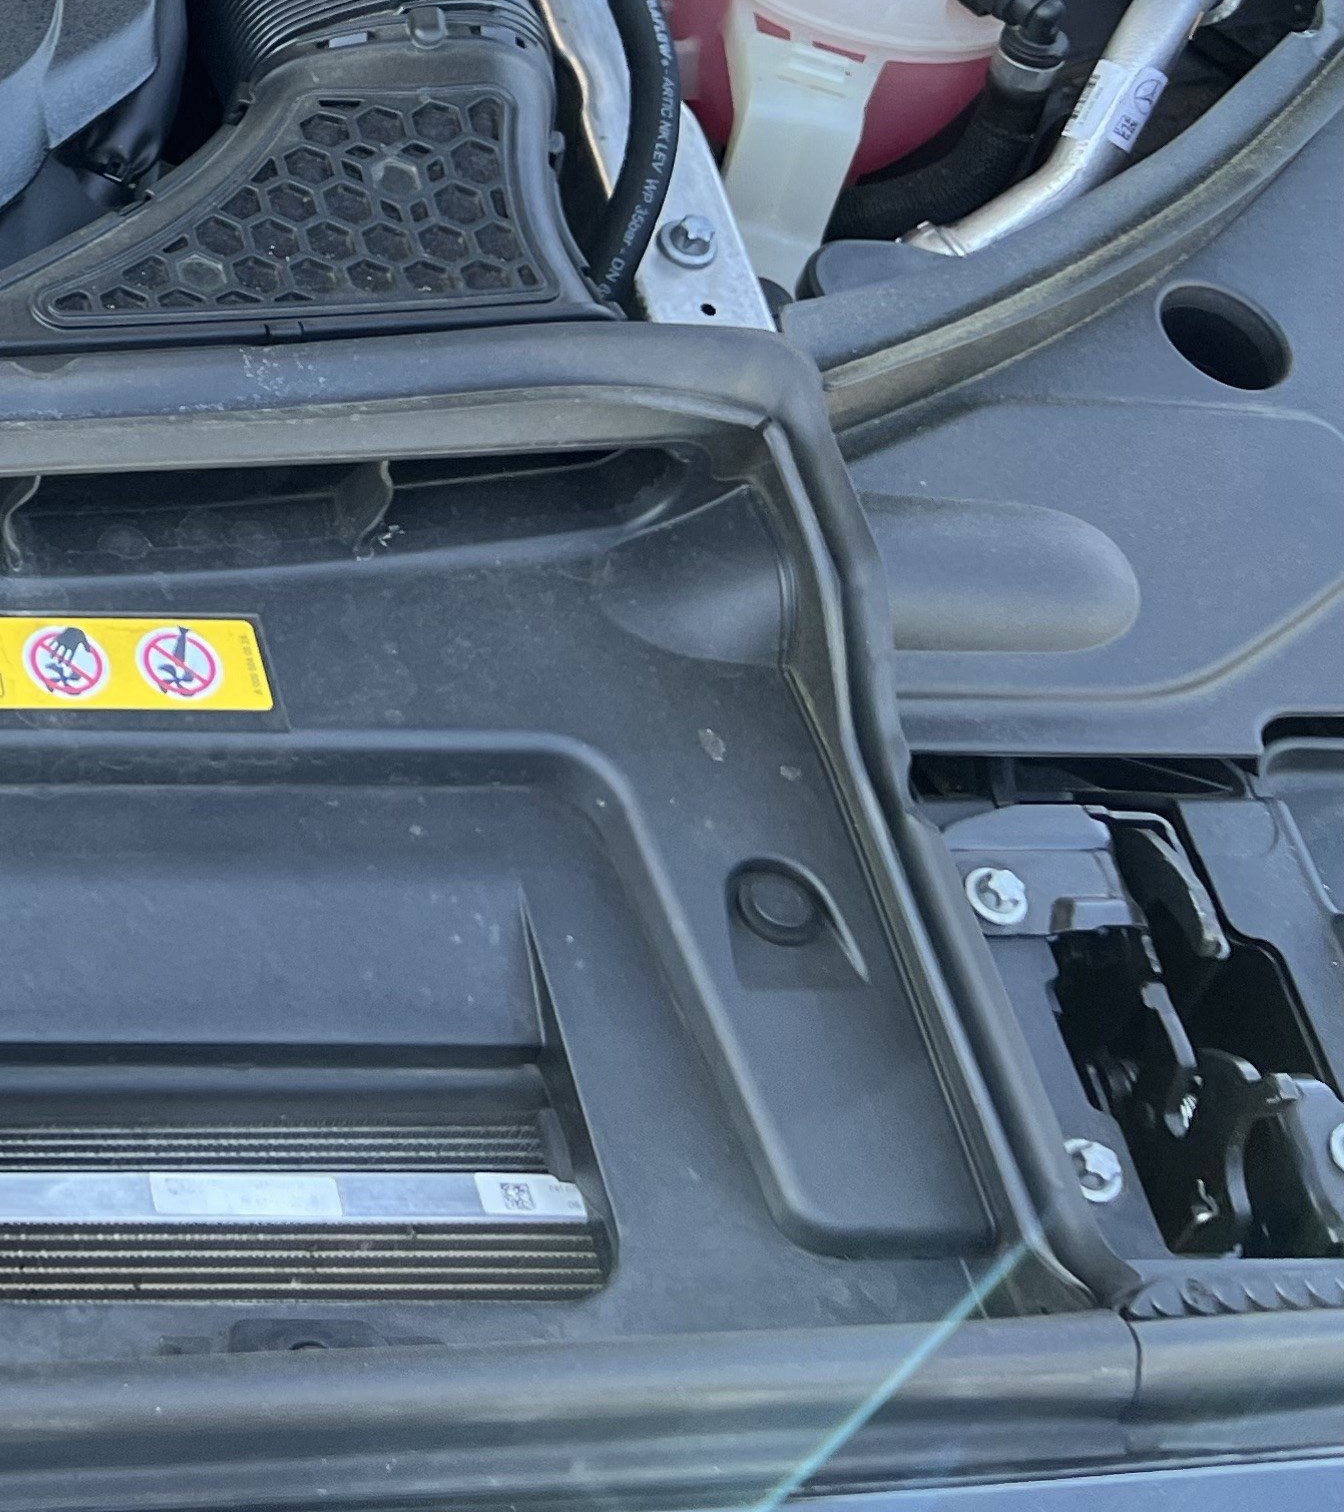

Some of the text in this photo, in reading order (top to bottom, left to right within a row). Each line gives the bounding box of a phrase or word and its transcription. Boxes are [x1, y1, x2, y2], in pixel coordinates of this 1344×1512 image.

[651, 142, 668, 174] LEV
[642, 178, 660, 204] WP
[605, 257, 625, 283] DN
